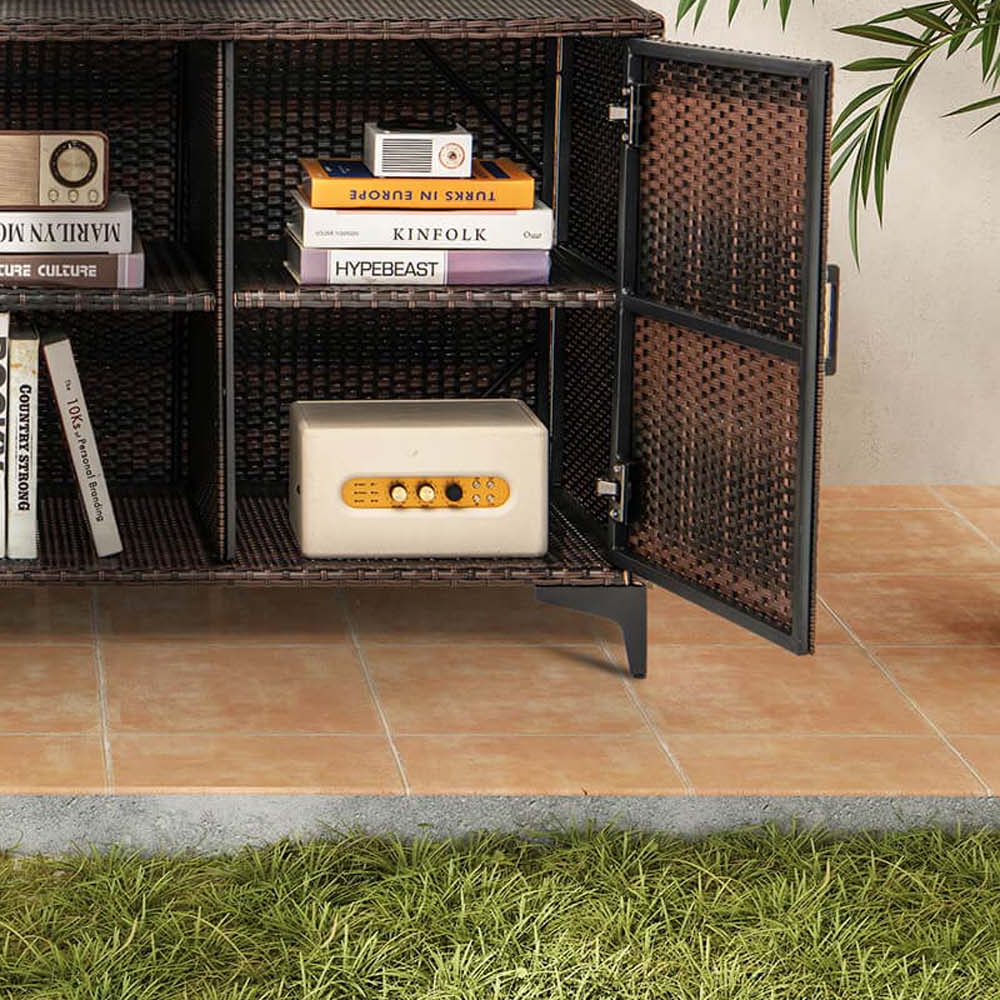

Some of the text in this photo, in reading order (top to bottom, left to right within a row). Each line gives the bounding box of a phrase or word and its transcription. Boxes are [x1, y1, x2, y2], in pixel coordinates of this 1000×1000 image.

[349, 189, 497, 201] TURKS IN EUROPE
[30, 222, 121, 243] MARILYN
[392, 227, 488, 242] KINFOLK
[37, 264, 97, 277] CULTURE
[335, 260, 440, 278] HYPEBEAST
[17, 384, 33, 511] COUNTRY STRONG
[77, 438, 97, 480] Personal
[88, 481, 105, 523] Branding
